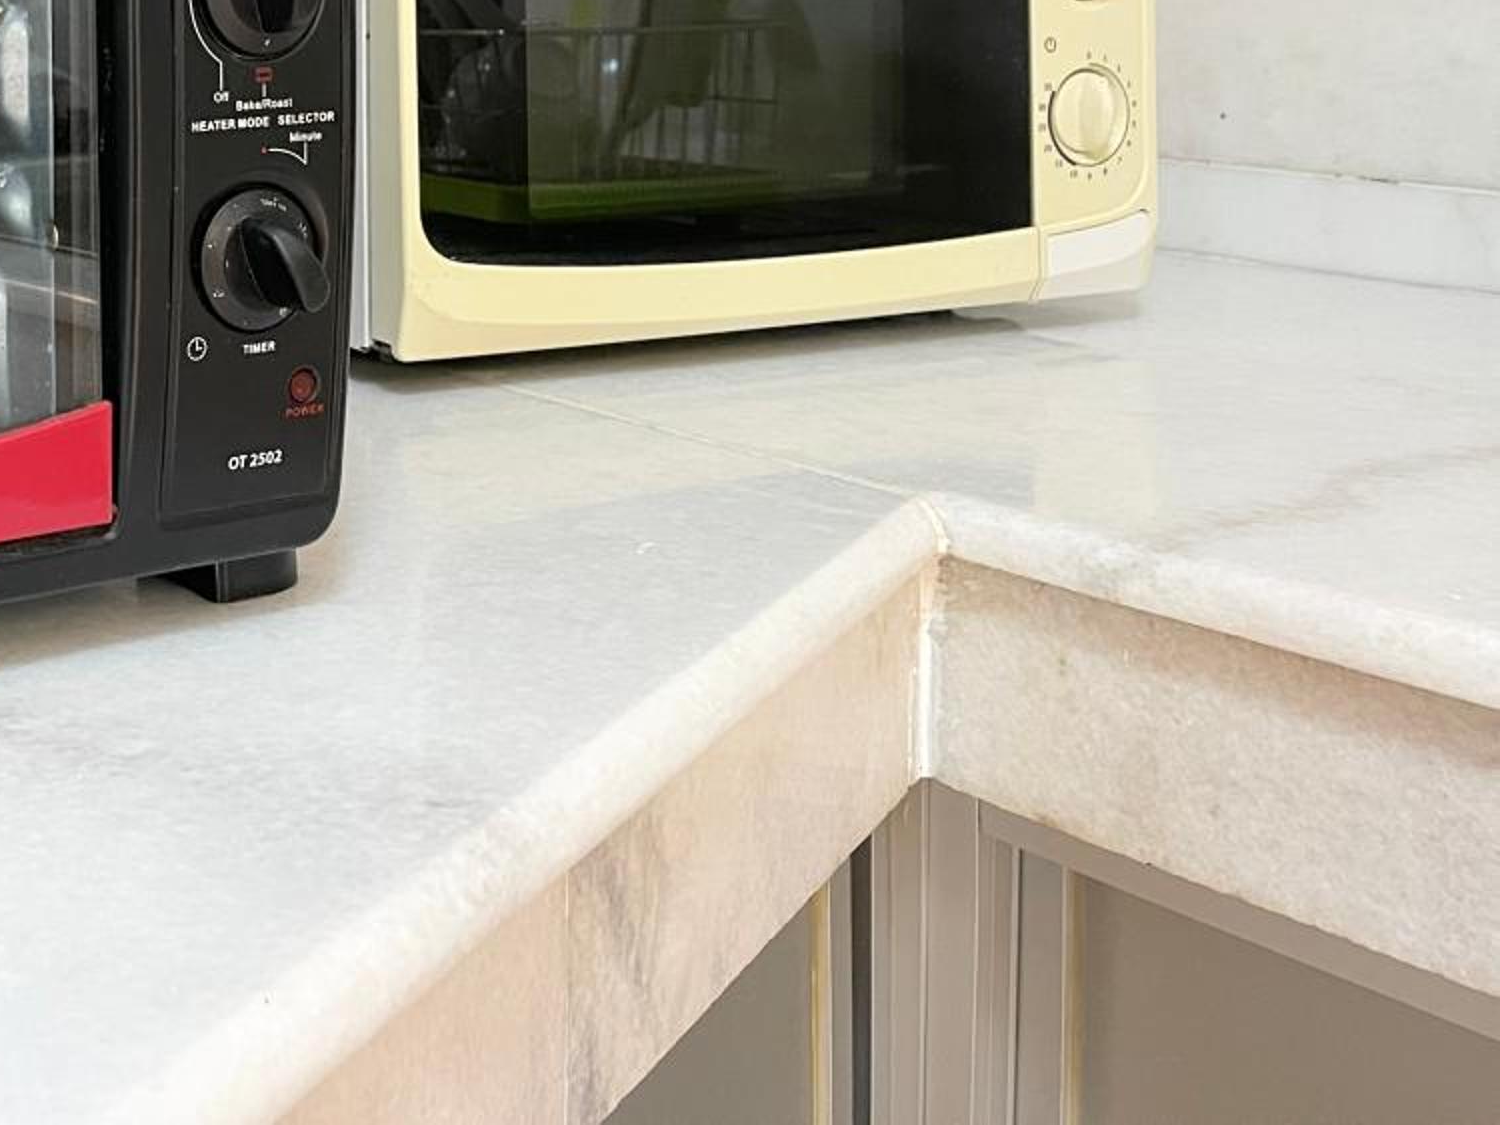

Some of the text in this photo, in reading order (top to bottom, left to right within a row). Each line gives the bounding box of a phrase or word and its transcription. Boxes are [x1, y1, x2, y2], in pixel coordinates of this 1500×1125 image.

[191, 111, 335, 133] HEATER MODE SELECTOR
[243, 340, 276, 355] TIMER
[285, 403, 324, 418] POWER
[227, 448, 284, 471] OT 2502
